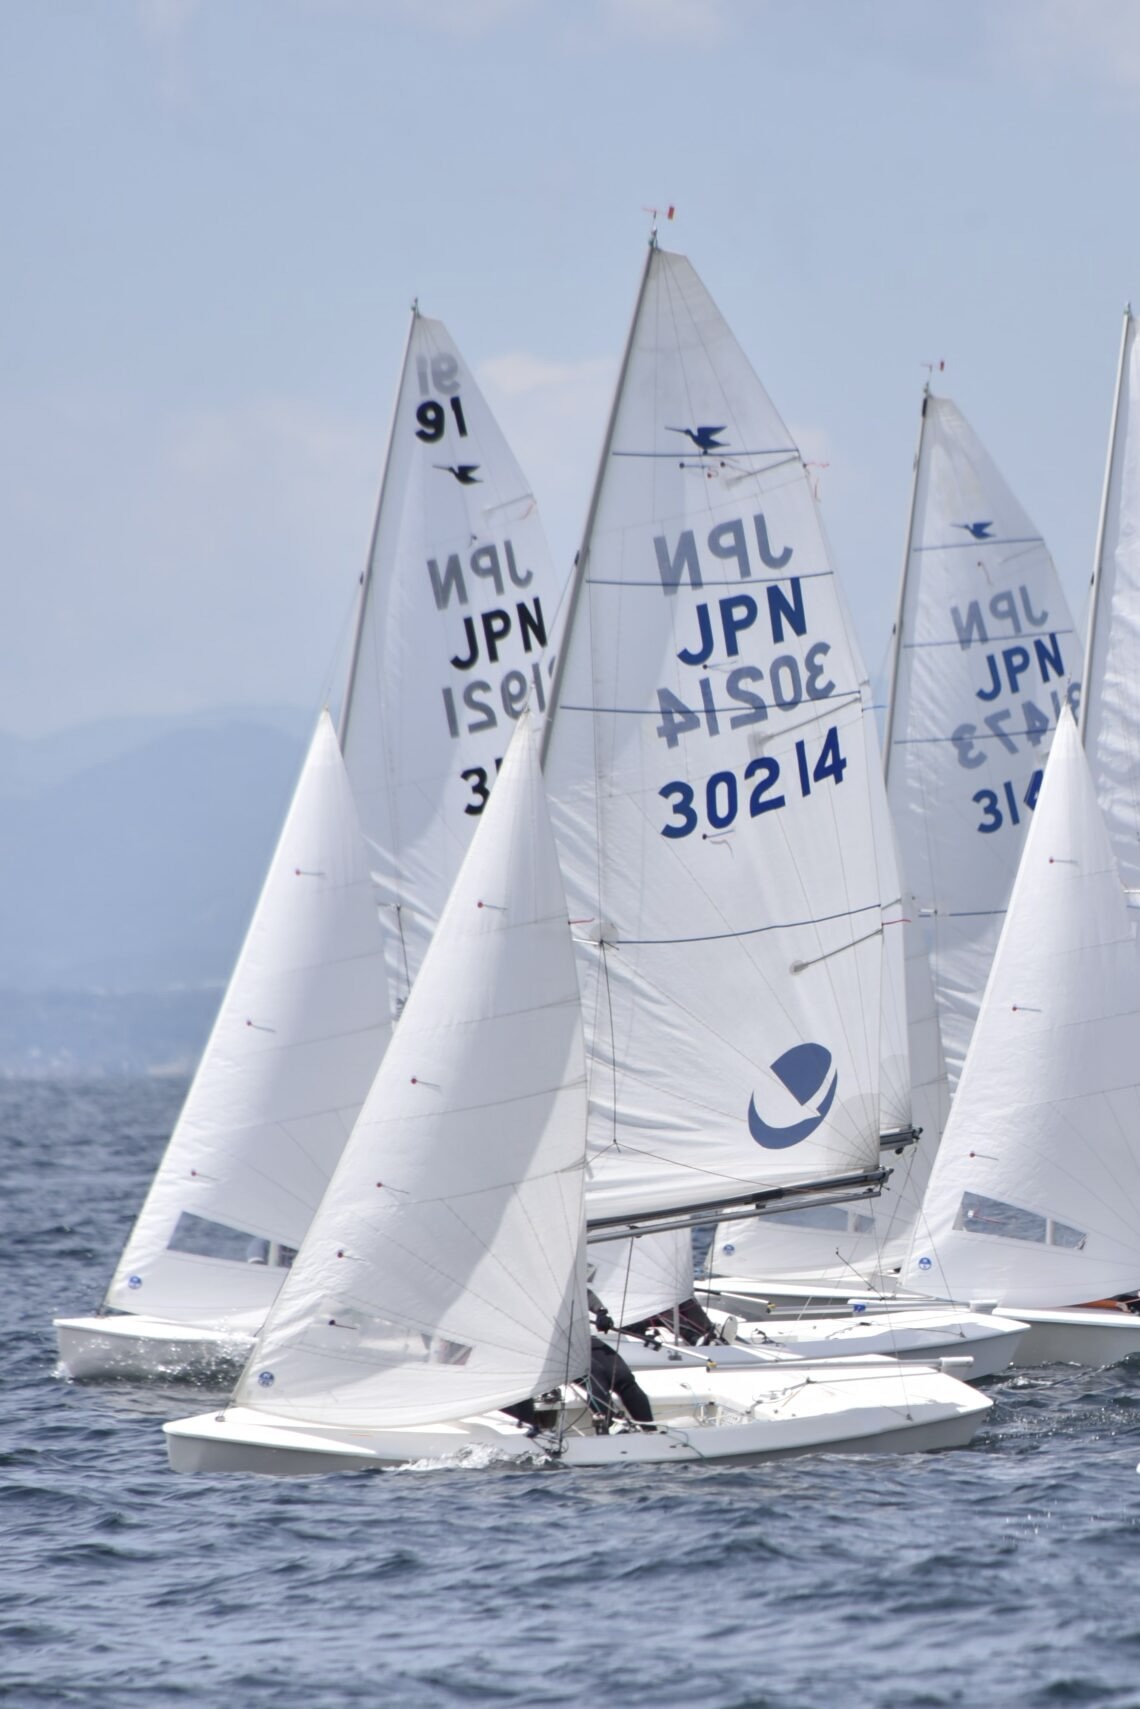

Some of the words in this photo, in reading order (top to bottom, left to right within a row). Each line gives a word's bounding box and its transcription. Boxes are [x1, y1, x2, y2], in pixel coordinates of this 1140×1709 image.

[415, 396, 467, 443] 91
[450, 597, 548, 670] JPN
[677, 577, 807, 667] JPN
[976, 632, 1065, 701] JPN
[657, 726, 847, 839] 30214
